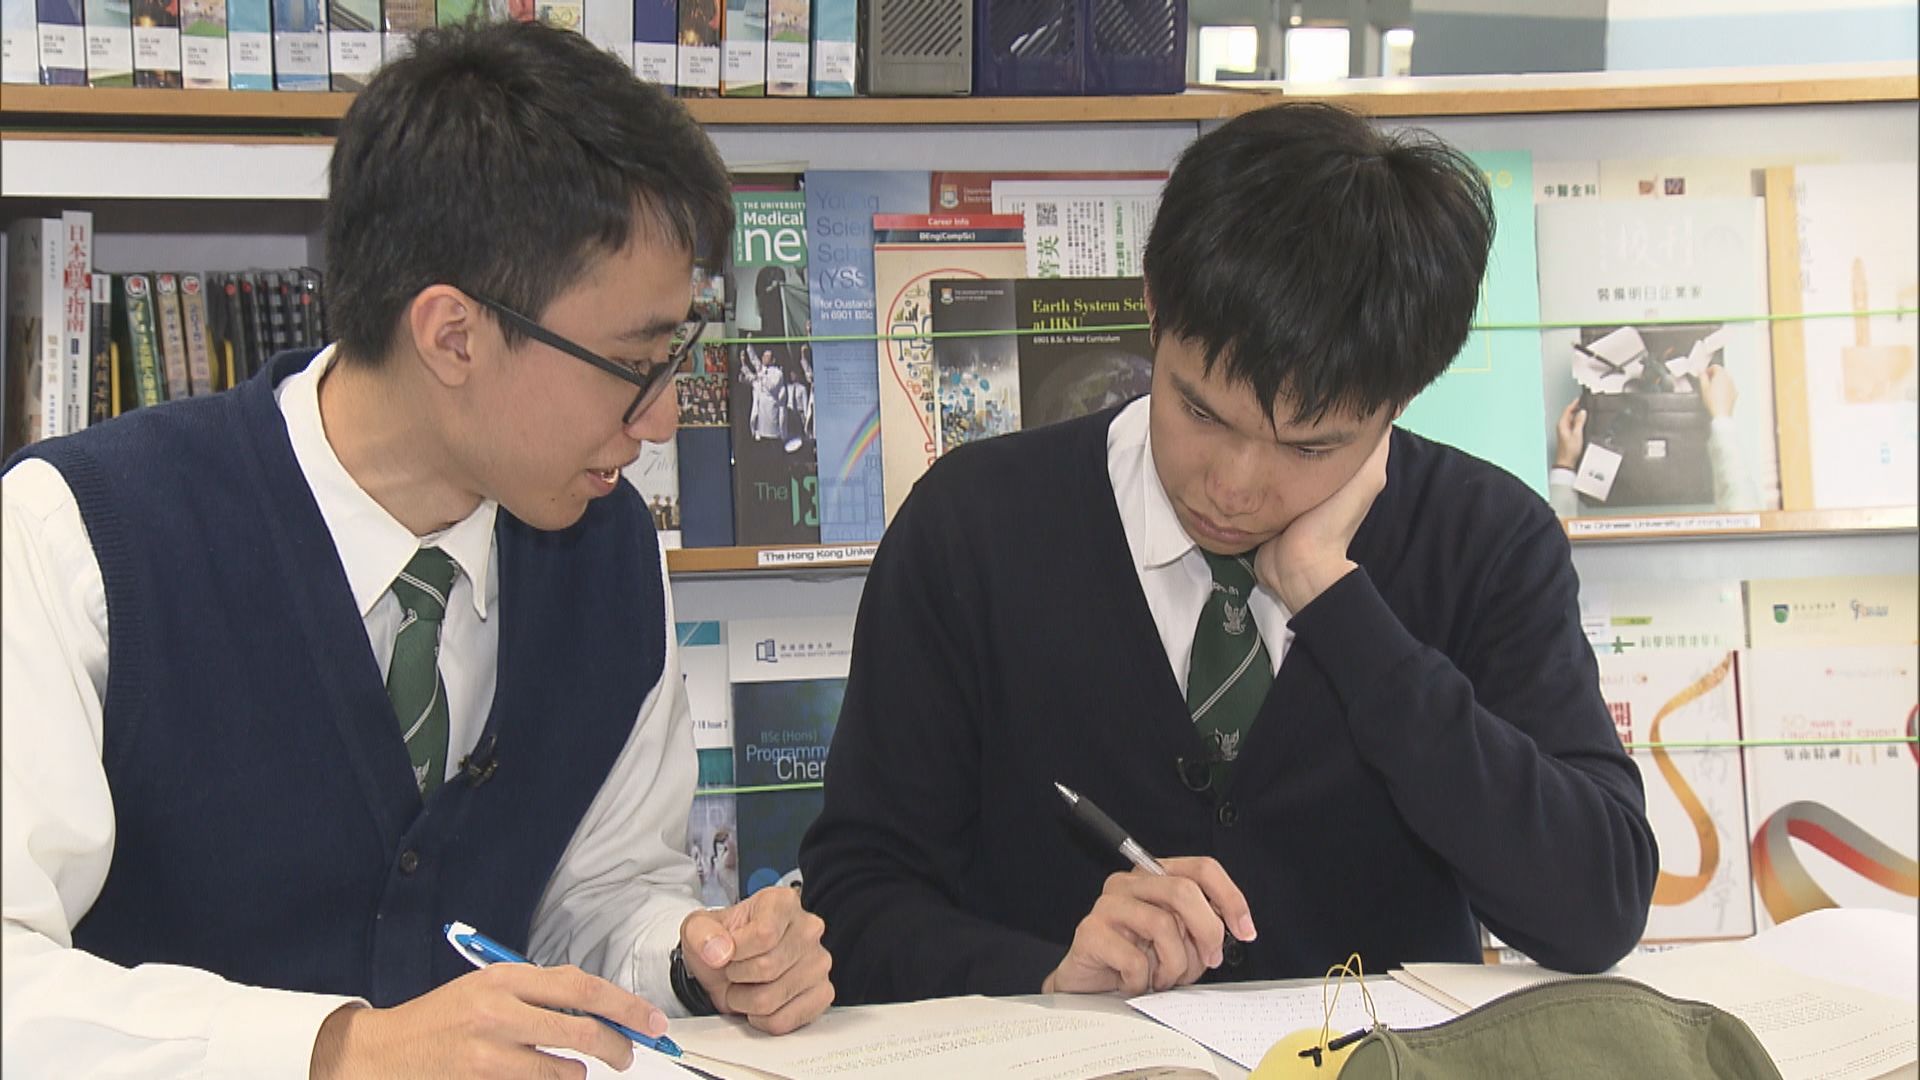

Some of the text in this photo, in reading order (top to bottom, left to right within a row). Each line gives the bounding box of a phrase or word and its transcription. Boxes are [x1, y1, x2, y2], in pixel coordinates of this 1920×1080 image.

[743, 210, 804, 225] Medical
[928, 217, 970, 226] Career Info
[744, 227, 808, 262] ne
[1032, 298, 1070, 313] Earth
[1074, 298, 1120, 317] System
[1086, 334, 1121, 343] Curriculum
[755, 481, 787, 500] The
[764, 552, 784, 561] The
[787, 551, 814, 561] Hong
[816, 549, 843, 560] Kong
